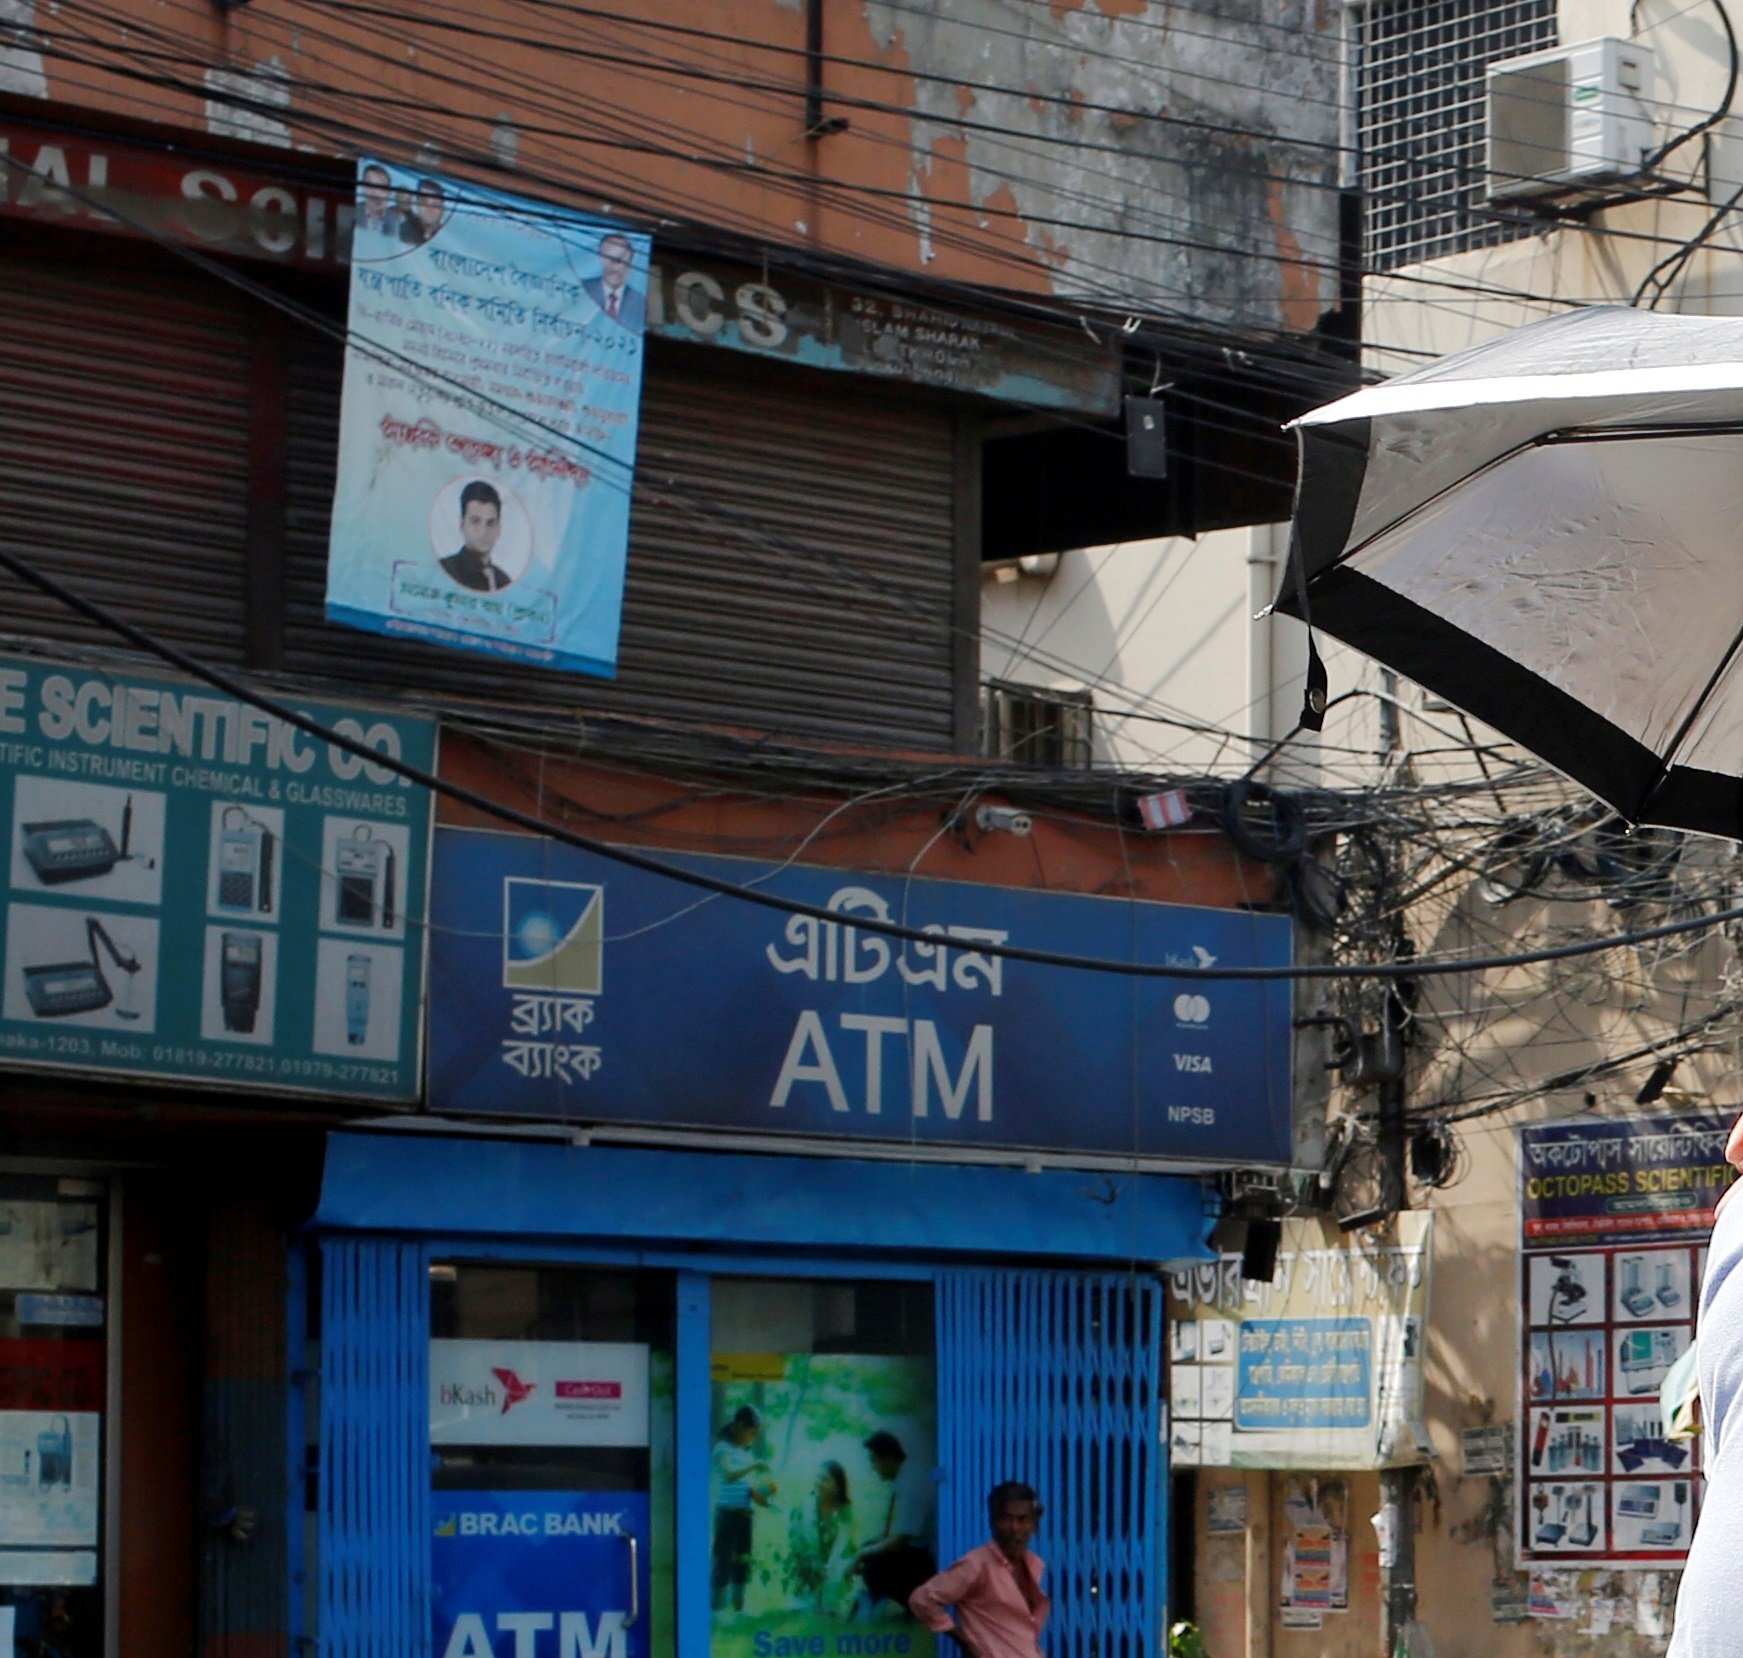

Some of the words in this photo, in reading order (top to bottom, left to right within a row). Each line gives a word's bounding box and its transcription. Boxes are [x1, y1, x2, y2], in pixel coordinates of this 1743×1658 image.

[0, 138, 114, 220] AL
[39, 675, 315, 773] SCIENTIFIC
[328, 718, 412, 788] CO.
[49, 748, 167, 785] INSTRUMENT
[171, 766, 264, 798] CHEMICAL
[269, 780, 281, 797] &
[766, 886, 1009, 997] এটিএম
[511, 994, 595, 1035] ব্র্যাক
[502, 1039, 602, 1085] ব্যাংক
[769, 1010, 994, 1122] ATM
[1172, 1053, 1213, 1074] VISA
[1168, 1105, 1215, 1126] NPSB
[1527, 1171, 1629, 1200] OCTOPASS
[440, 1383, 496, 1407] bKash
[460, 1513, 538, 1536] BRAC
[544, 1513, 622, 1536] BANK
[754, 1630, 825, 1658] Save
[838, 1633, 911, 1656] more
